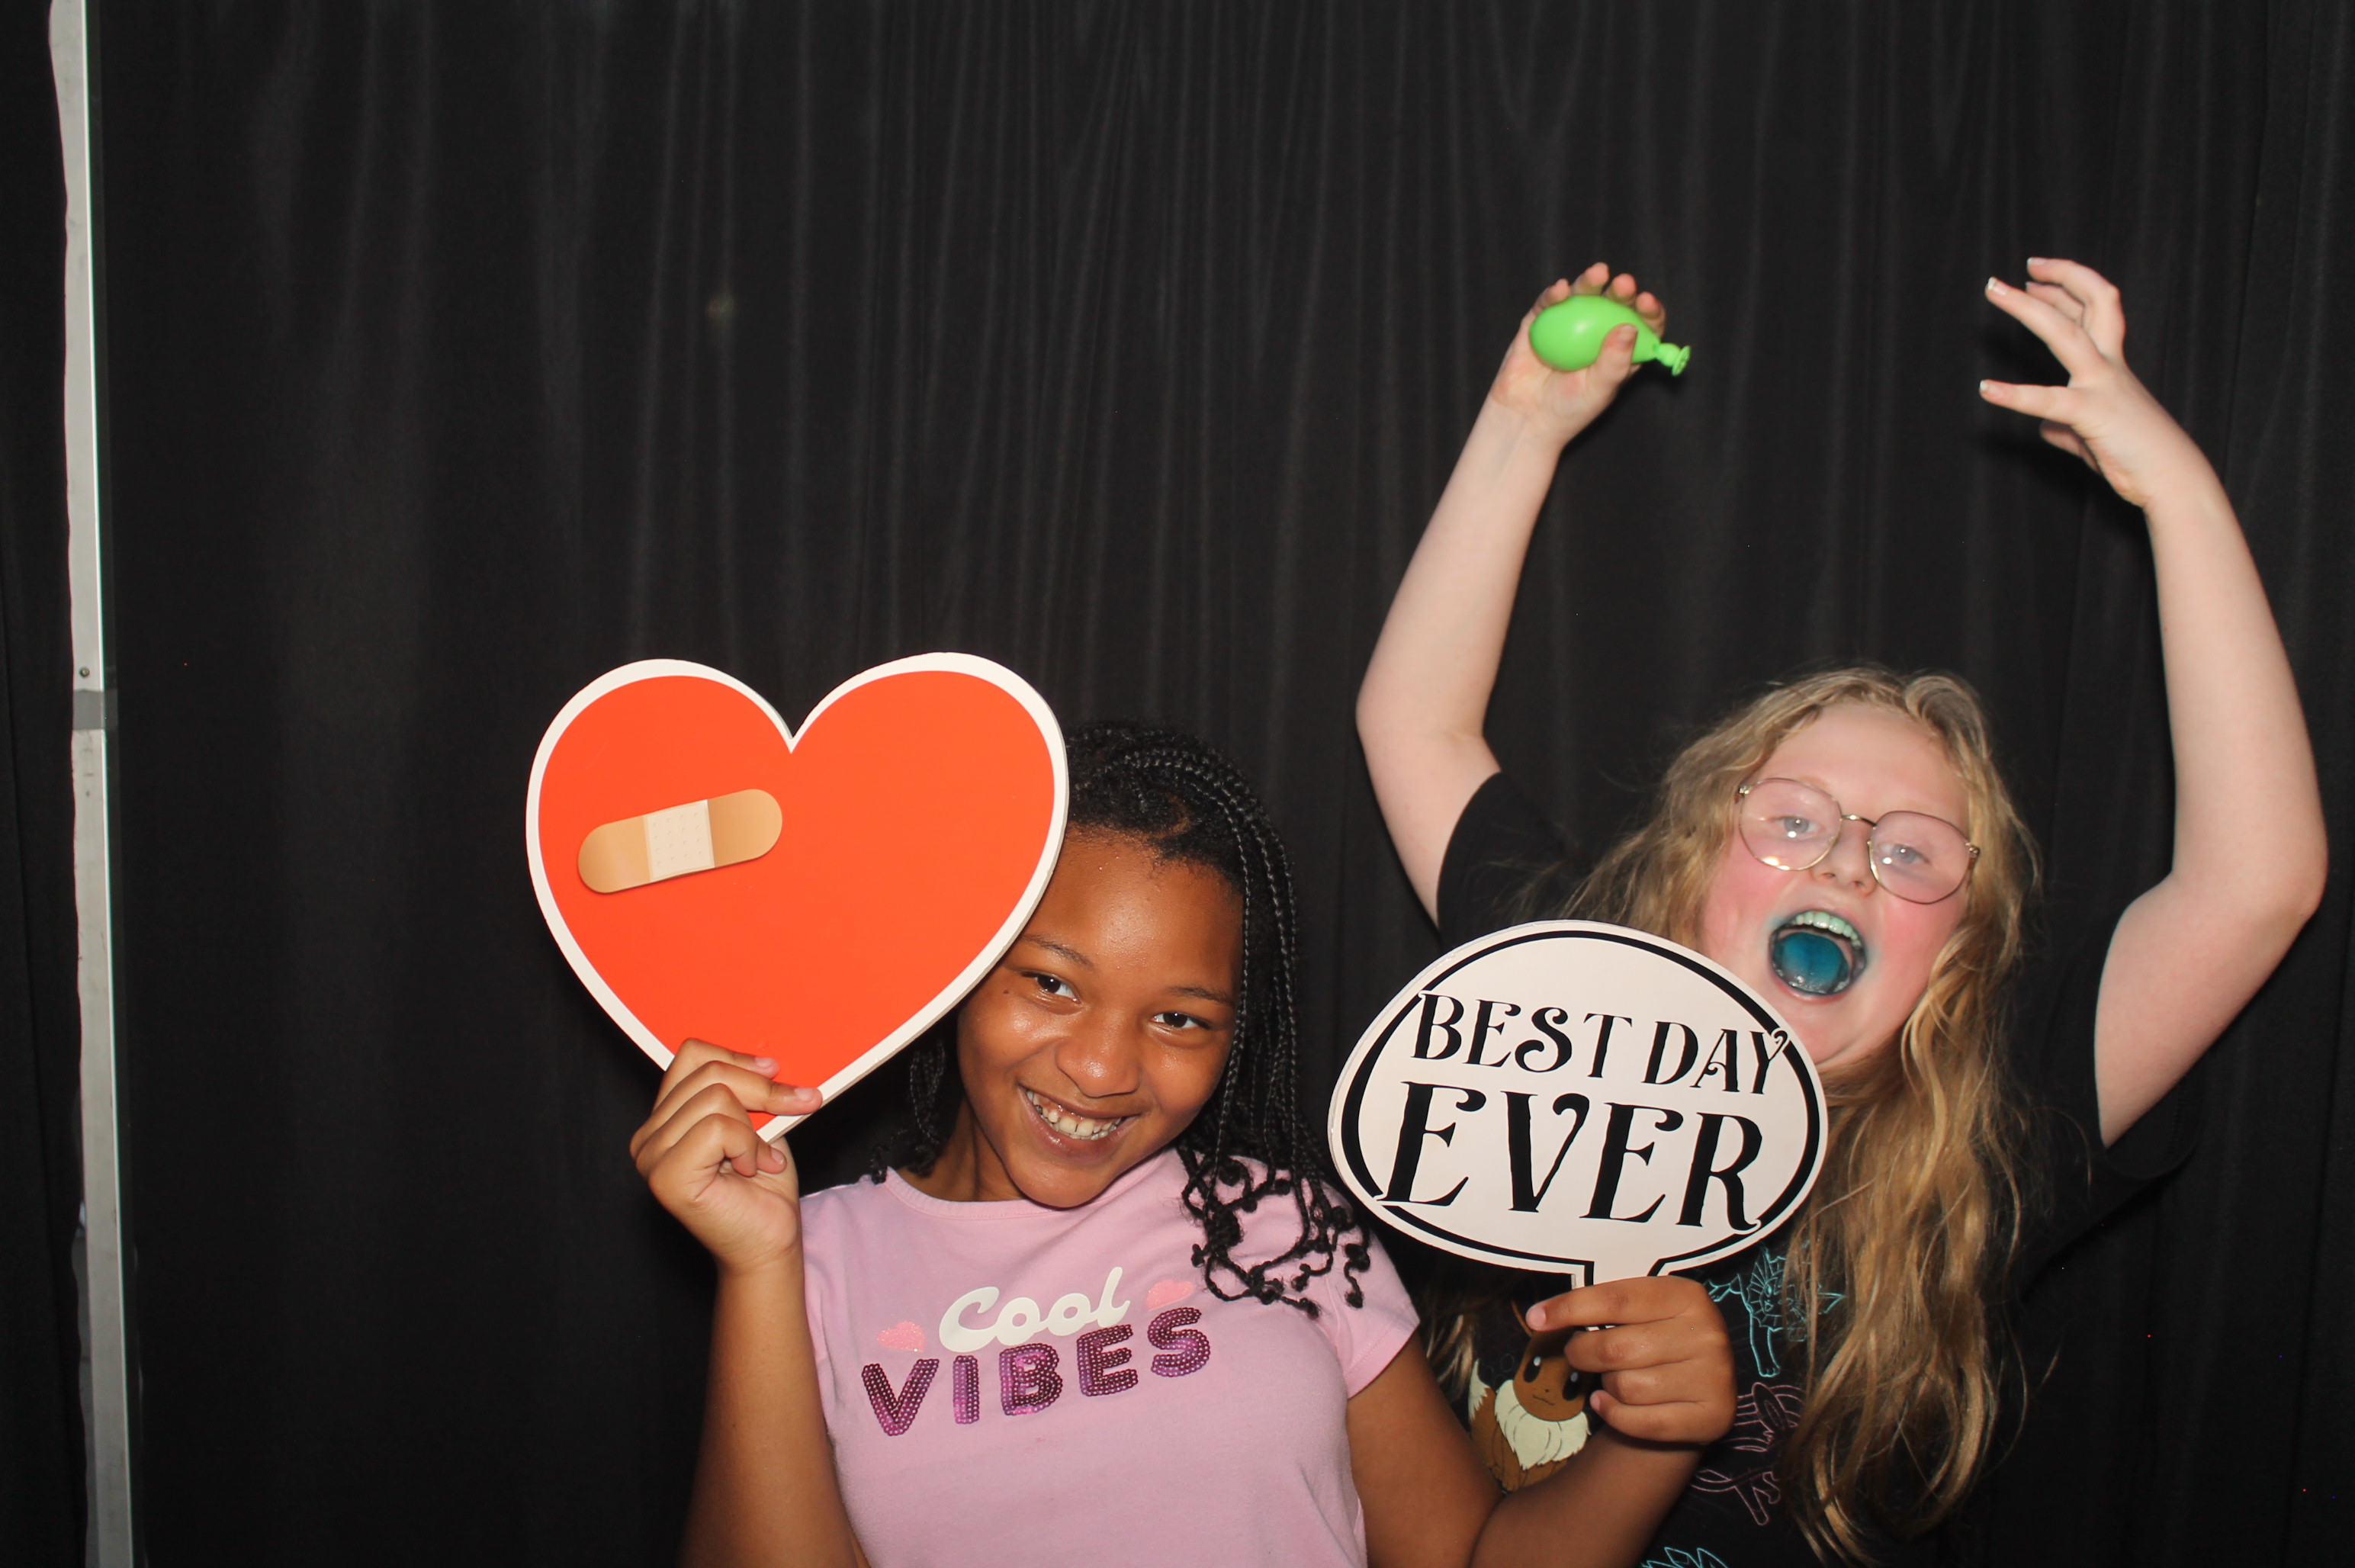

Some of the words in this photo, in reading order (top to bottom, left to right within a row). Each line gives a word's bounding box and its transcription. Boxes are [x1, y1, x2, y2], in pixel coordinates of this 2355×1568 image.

[1411, 993, 1632, 1078] BEST
[1641, 1020, 1788, 1094] DAY
[1377, 1081, 1762, 1231] EVER
[939, 1266, 1130, 1352] Cool
[861, 1307, 1210, 1436] VIBES
